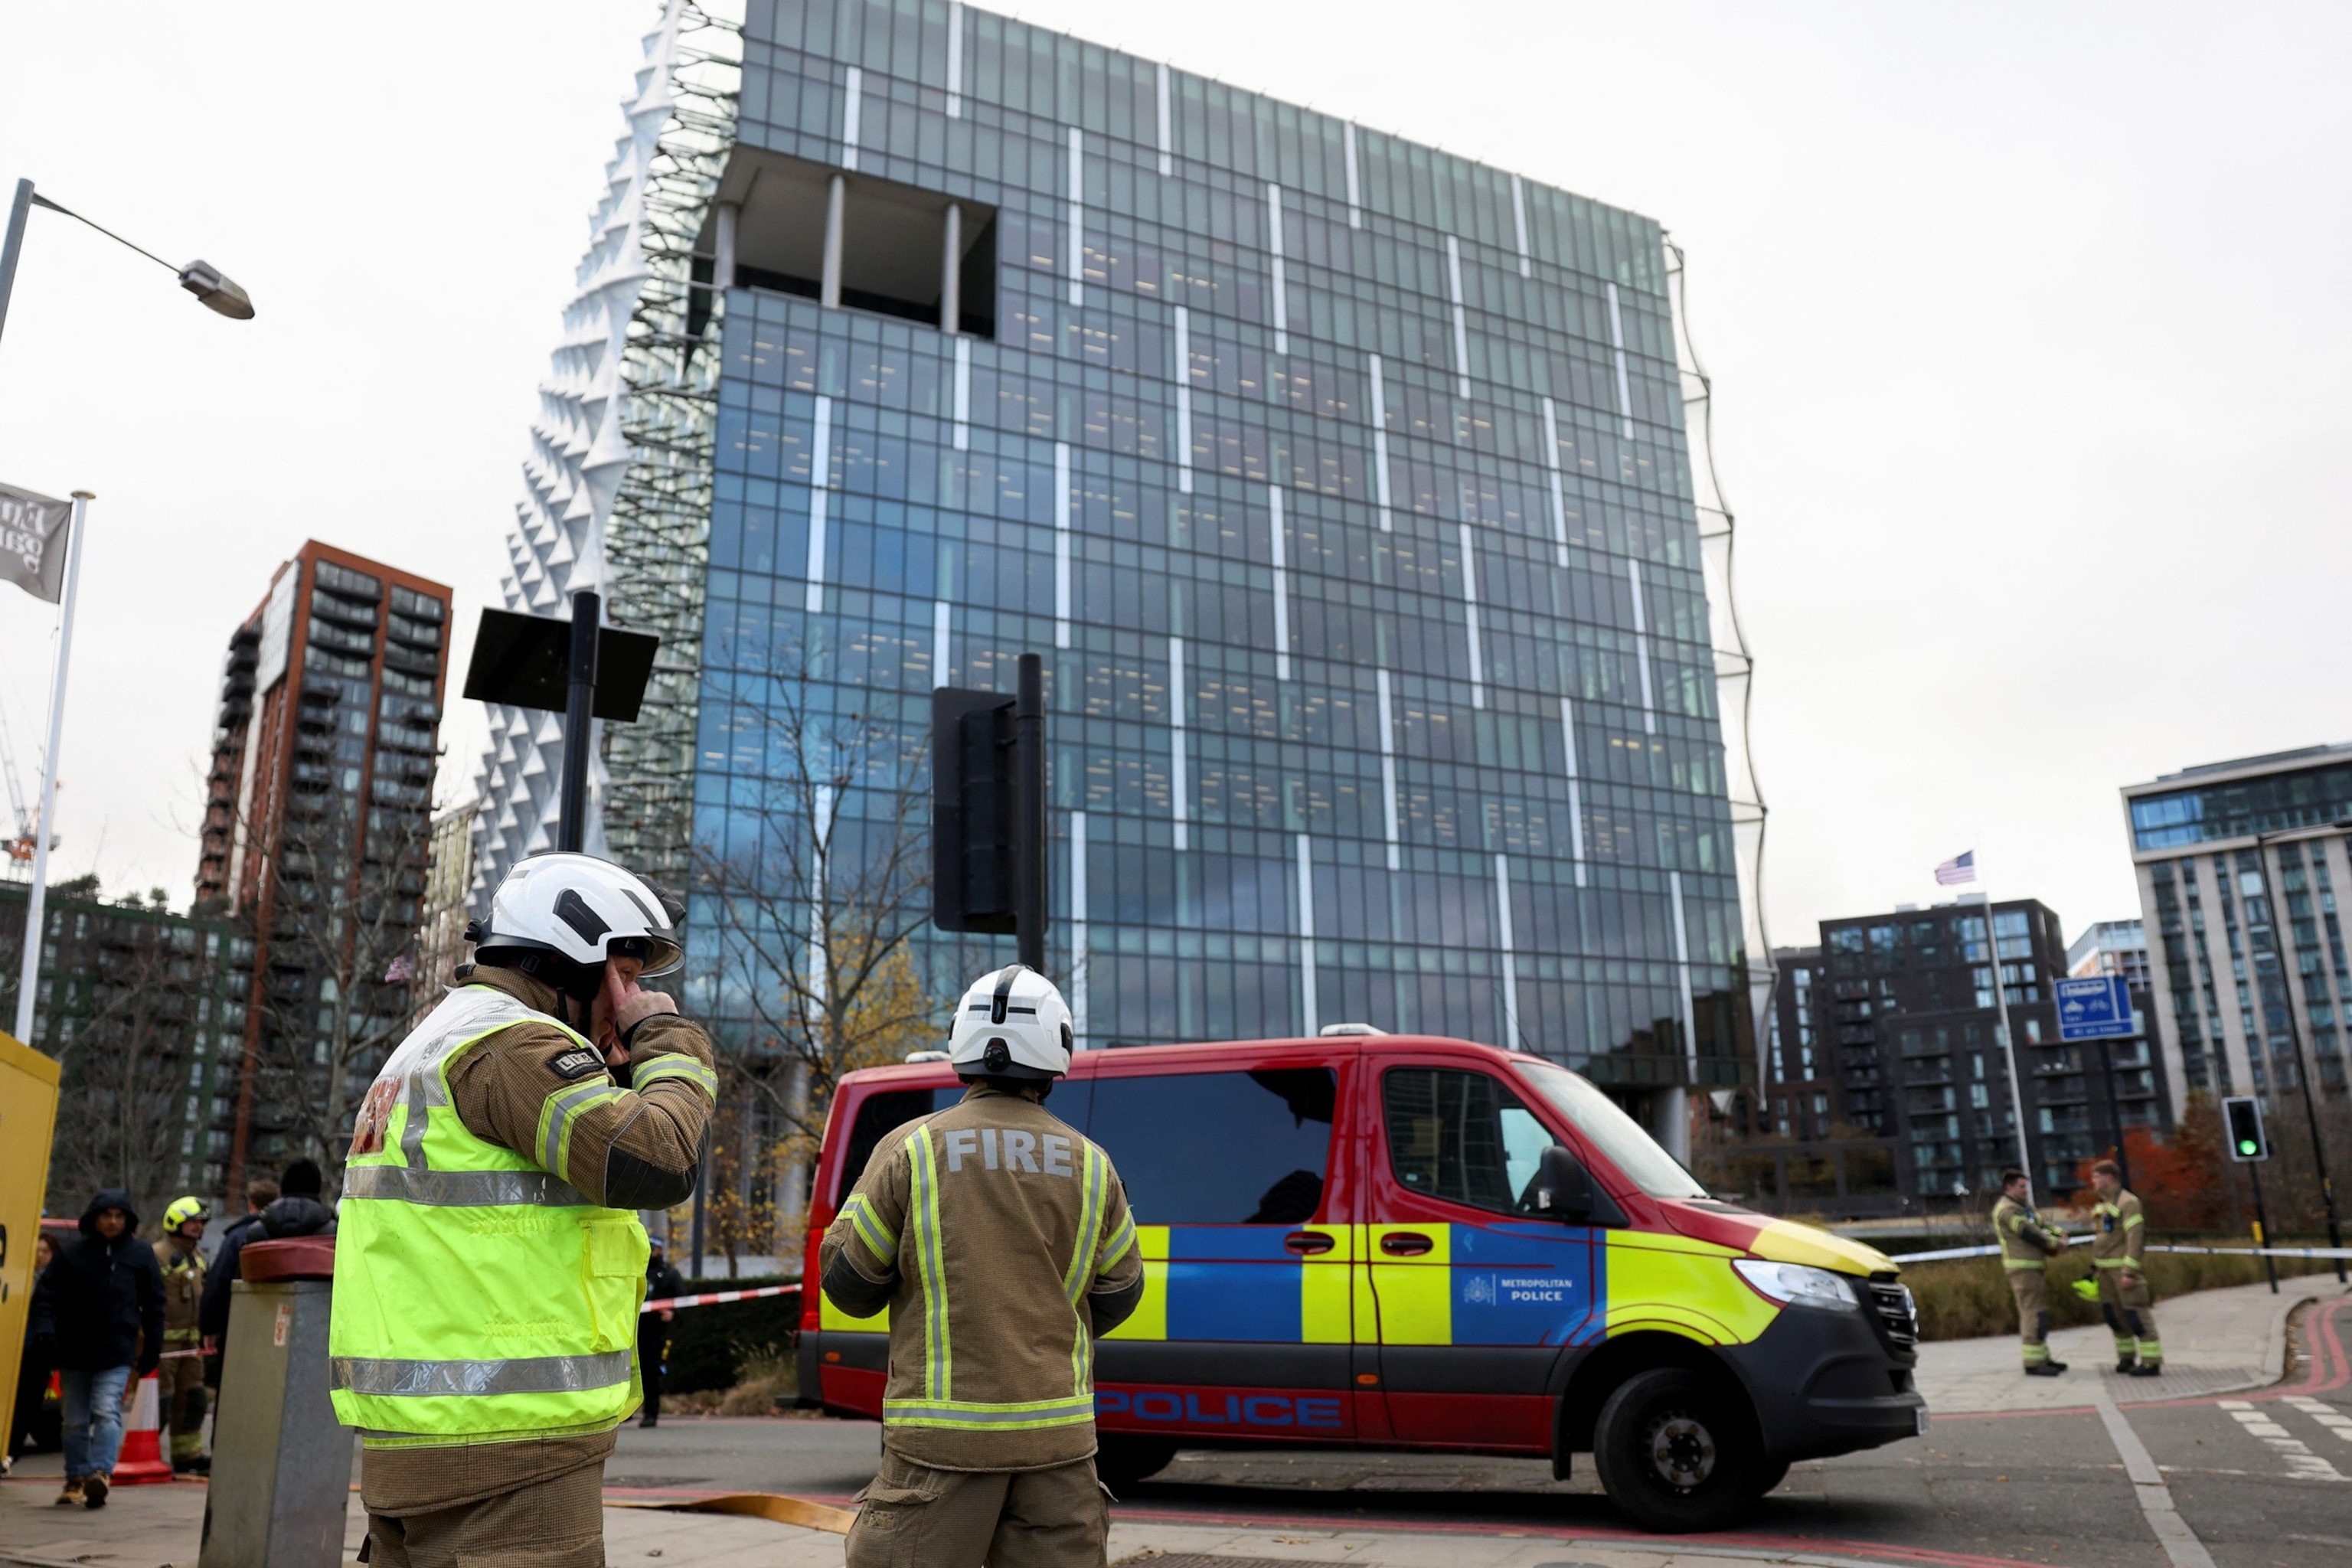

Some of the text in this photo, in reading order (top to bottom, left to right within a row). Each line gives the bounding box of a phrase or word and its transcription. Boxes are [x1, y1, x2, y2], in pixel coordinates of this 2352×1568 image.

[945, 1128, 1072, 1178] FIRE
[1501, 1279, 1573, 1289] METROPOLITAN
[1511, 1290, 1563, 1302] POLICE
[1095, 1390, 1343, 1428] POLICE
